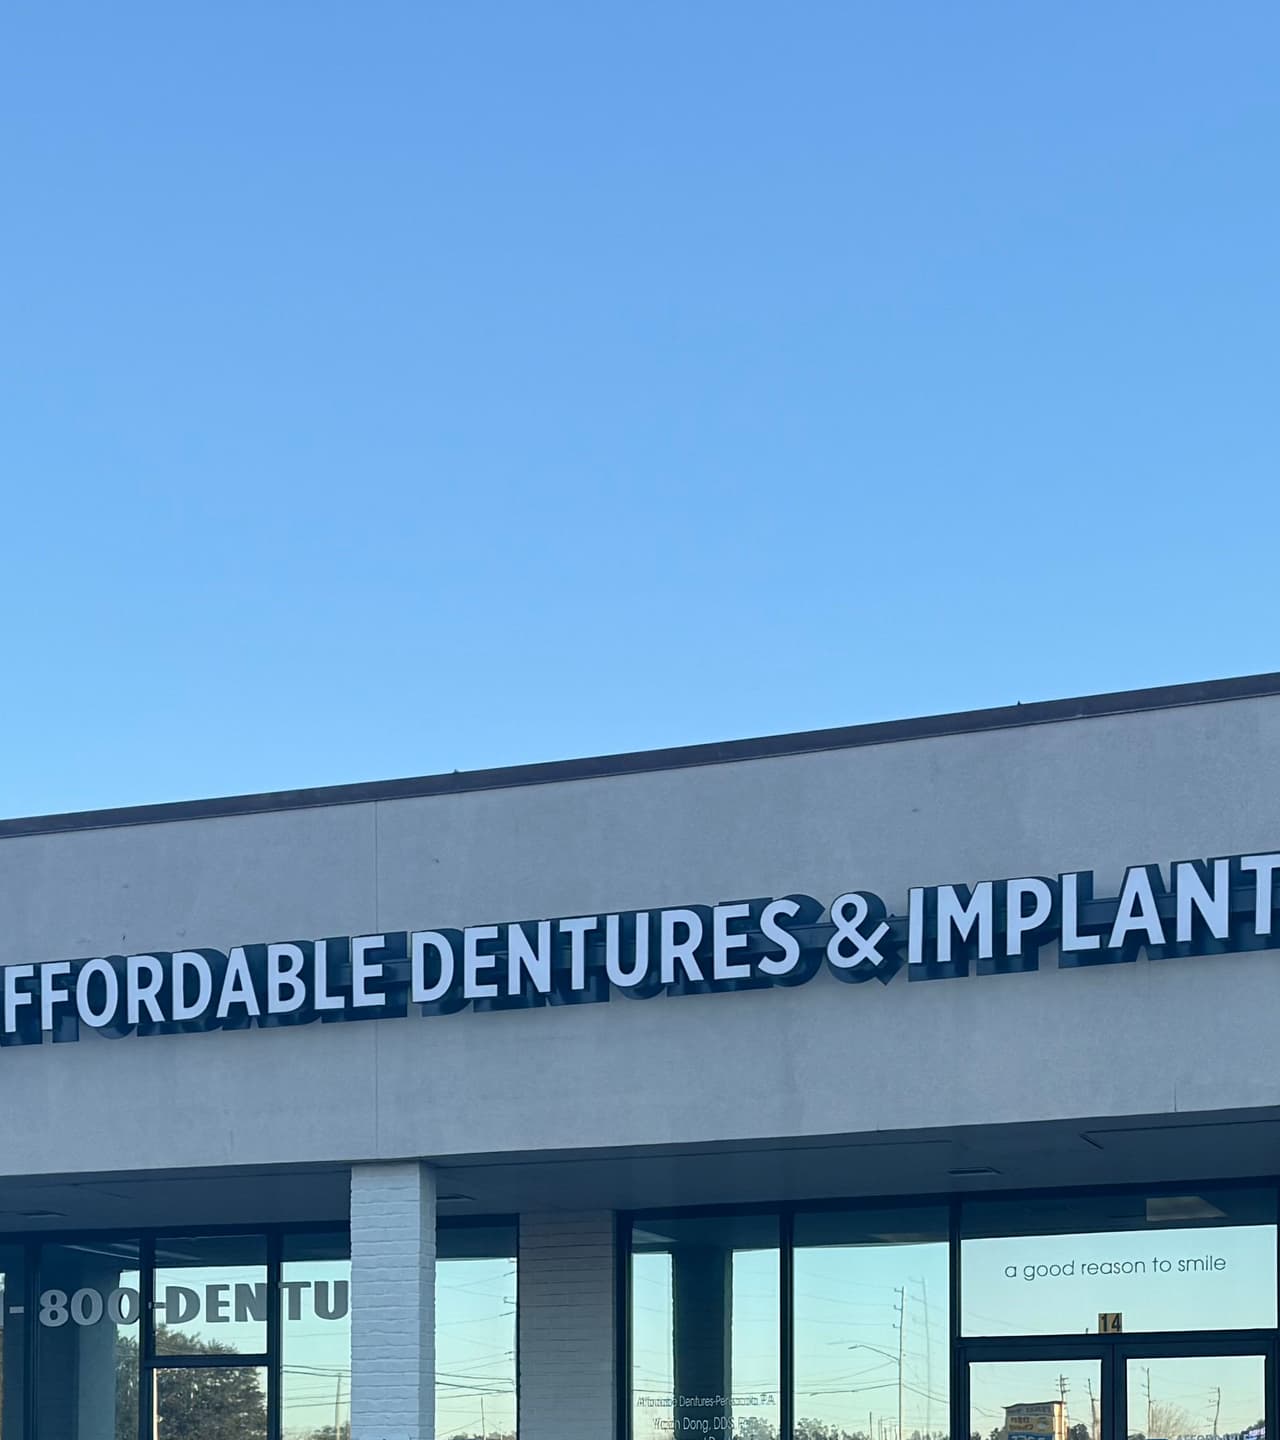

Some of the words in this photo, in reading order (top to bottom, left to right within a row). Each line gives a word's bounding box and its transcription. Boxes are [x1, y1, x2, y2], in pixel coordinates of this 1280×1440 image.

[409, 898, 801, 1004] DENTURES
[826, 892, 890, 971] &
[1004, 1265, 1017, 1278] a
[1023, 1260, 1075, 1281] good
[1081, 1261, 1146, 1276] reason
[1152, 1256, 1172, 1273] to
[1177, 1254, 1227, 1272] smile
[1100, 1313, 1121, 1332] 14
